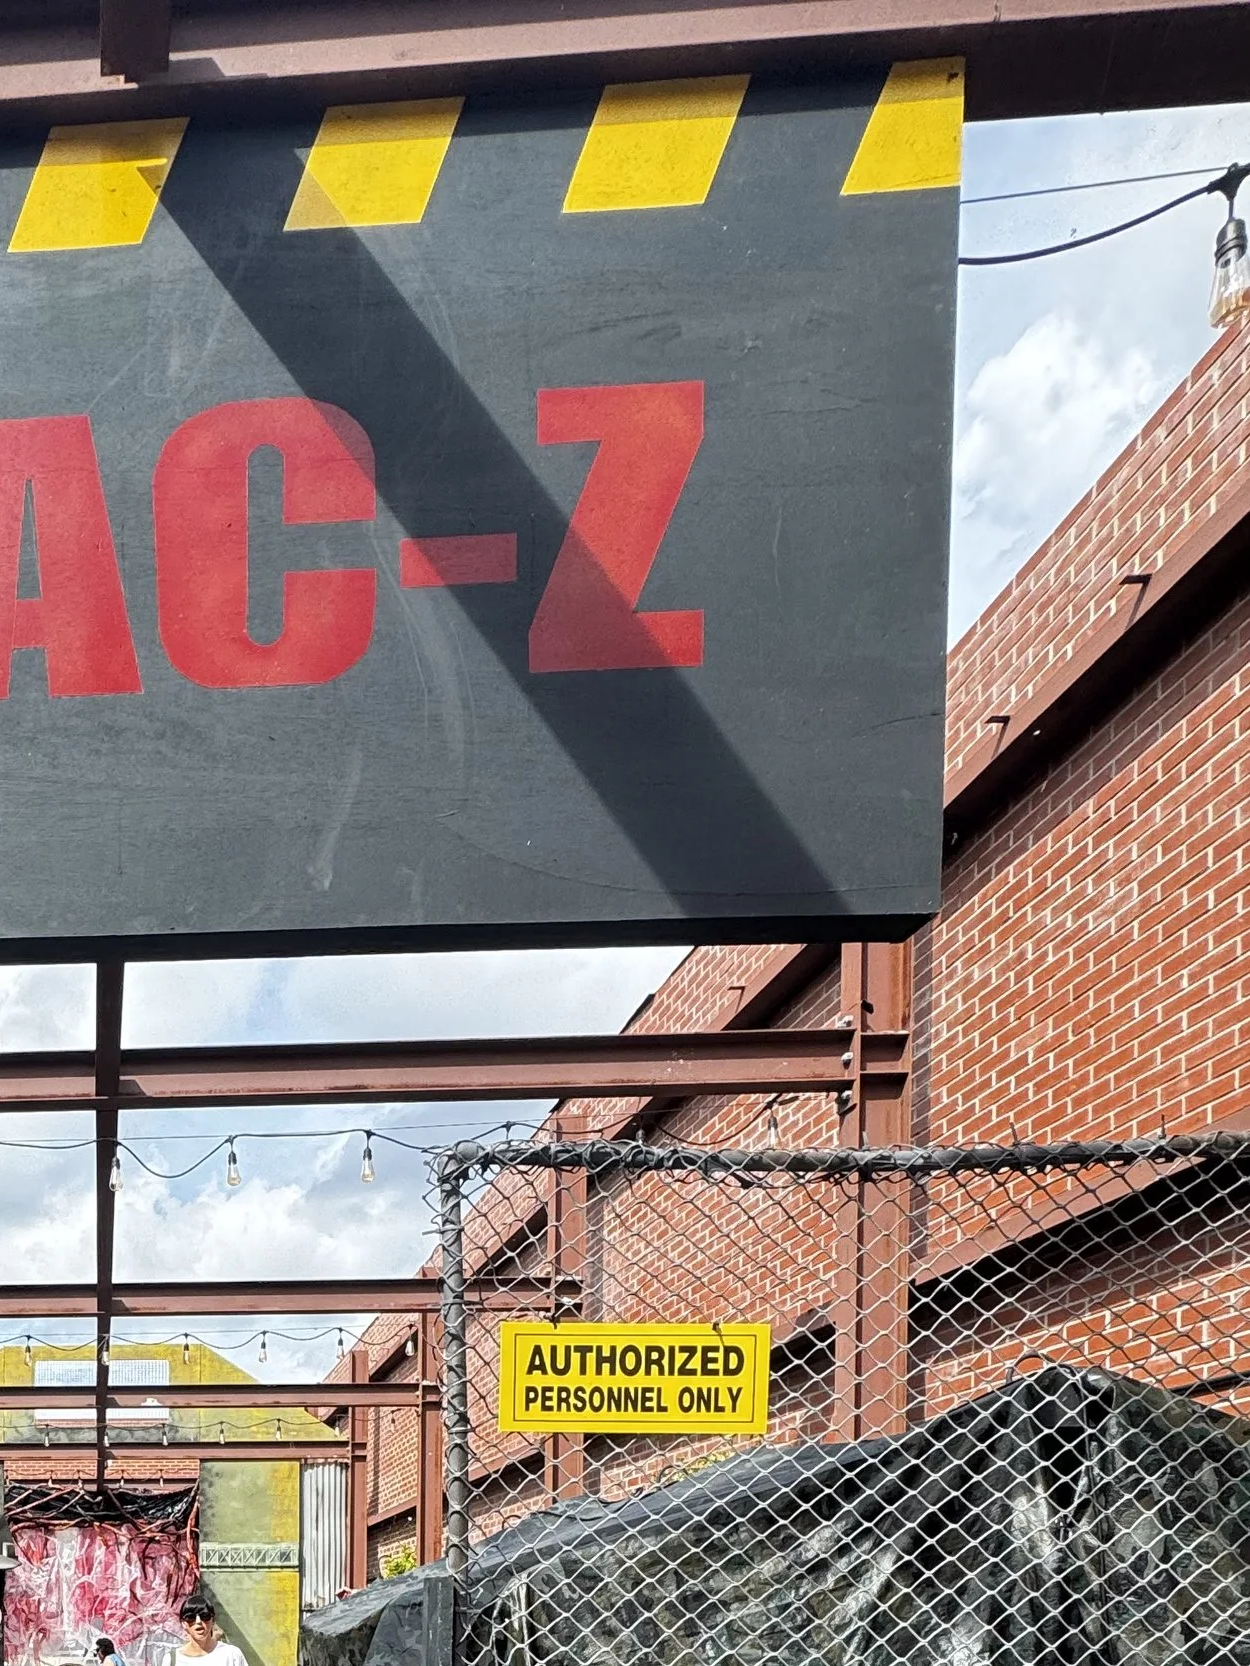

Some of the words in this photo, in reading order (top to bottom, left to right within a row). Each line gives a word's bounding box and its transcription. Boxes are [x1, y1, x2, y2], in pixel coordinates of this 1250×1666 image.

[525, 1344, 746, 1377] AUTHORIZED
[524, 1385, 668, 1413] PERSONNEL
[678, 1386, 744, 1413] ONLY
